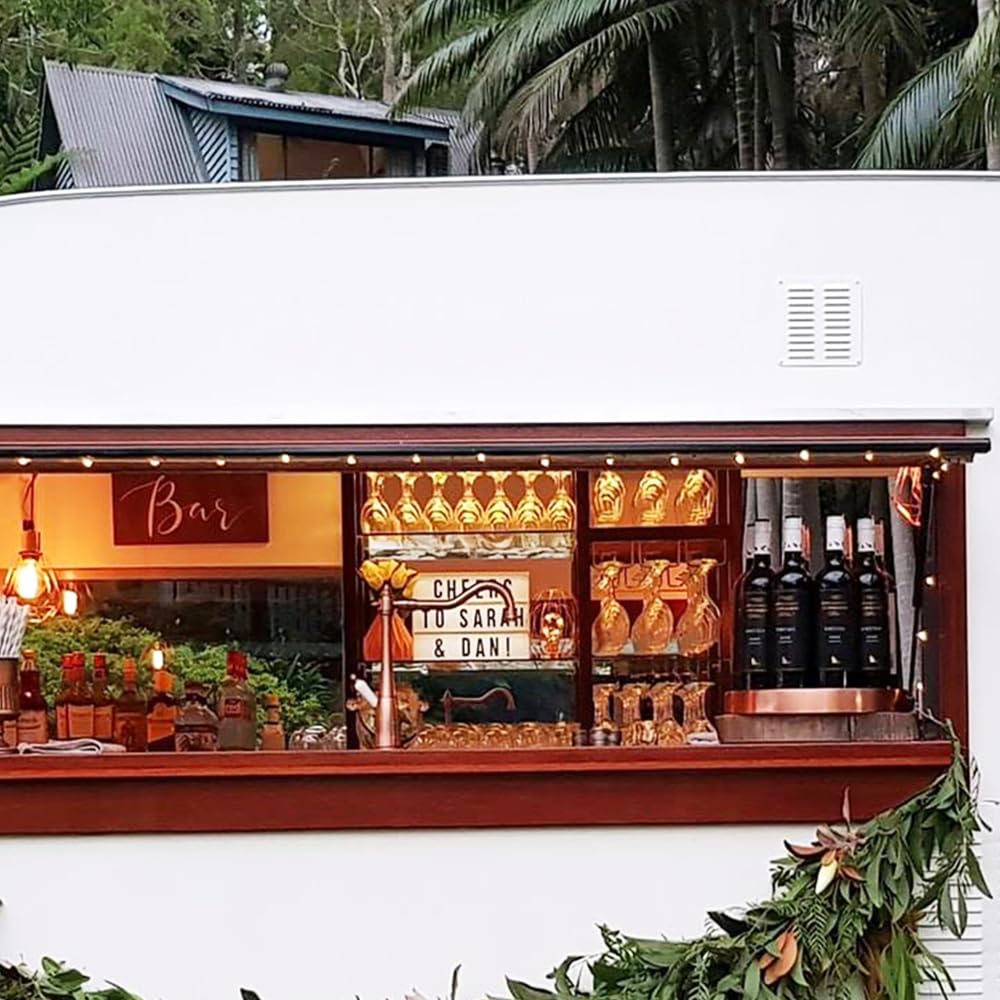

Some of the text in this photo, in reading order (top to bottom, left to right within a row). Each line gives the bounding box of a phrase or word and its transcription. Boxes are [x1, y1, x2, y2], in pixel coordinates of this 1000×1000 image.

[120, 475, 252, 538] Bar
[434, 637, 510, 658] & DAN!
